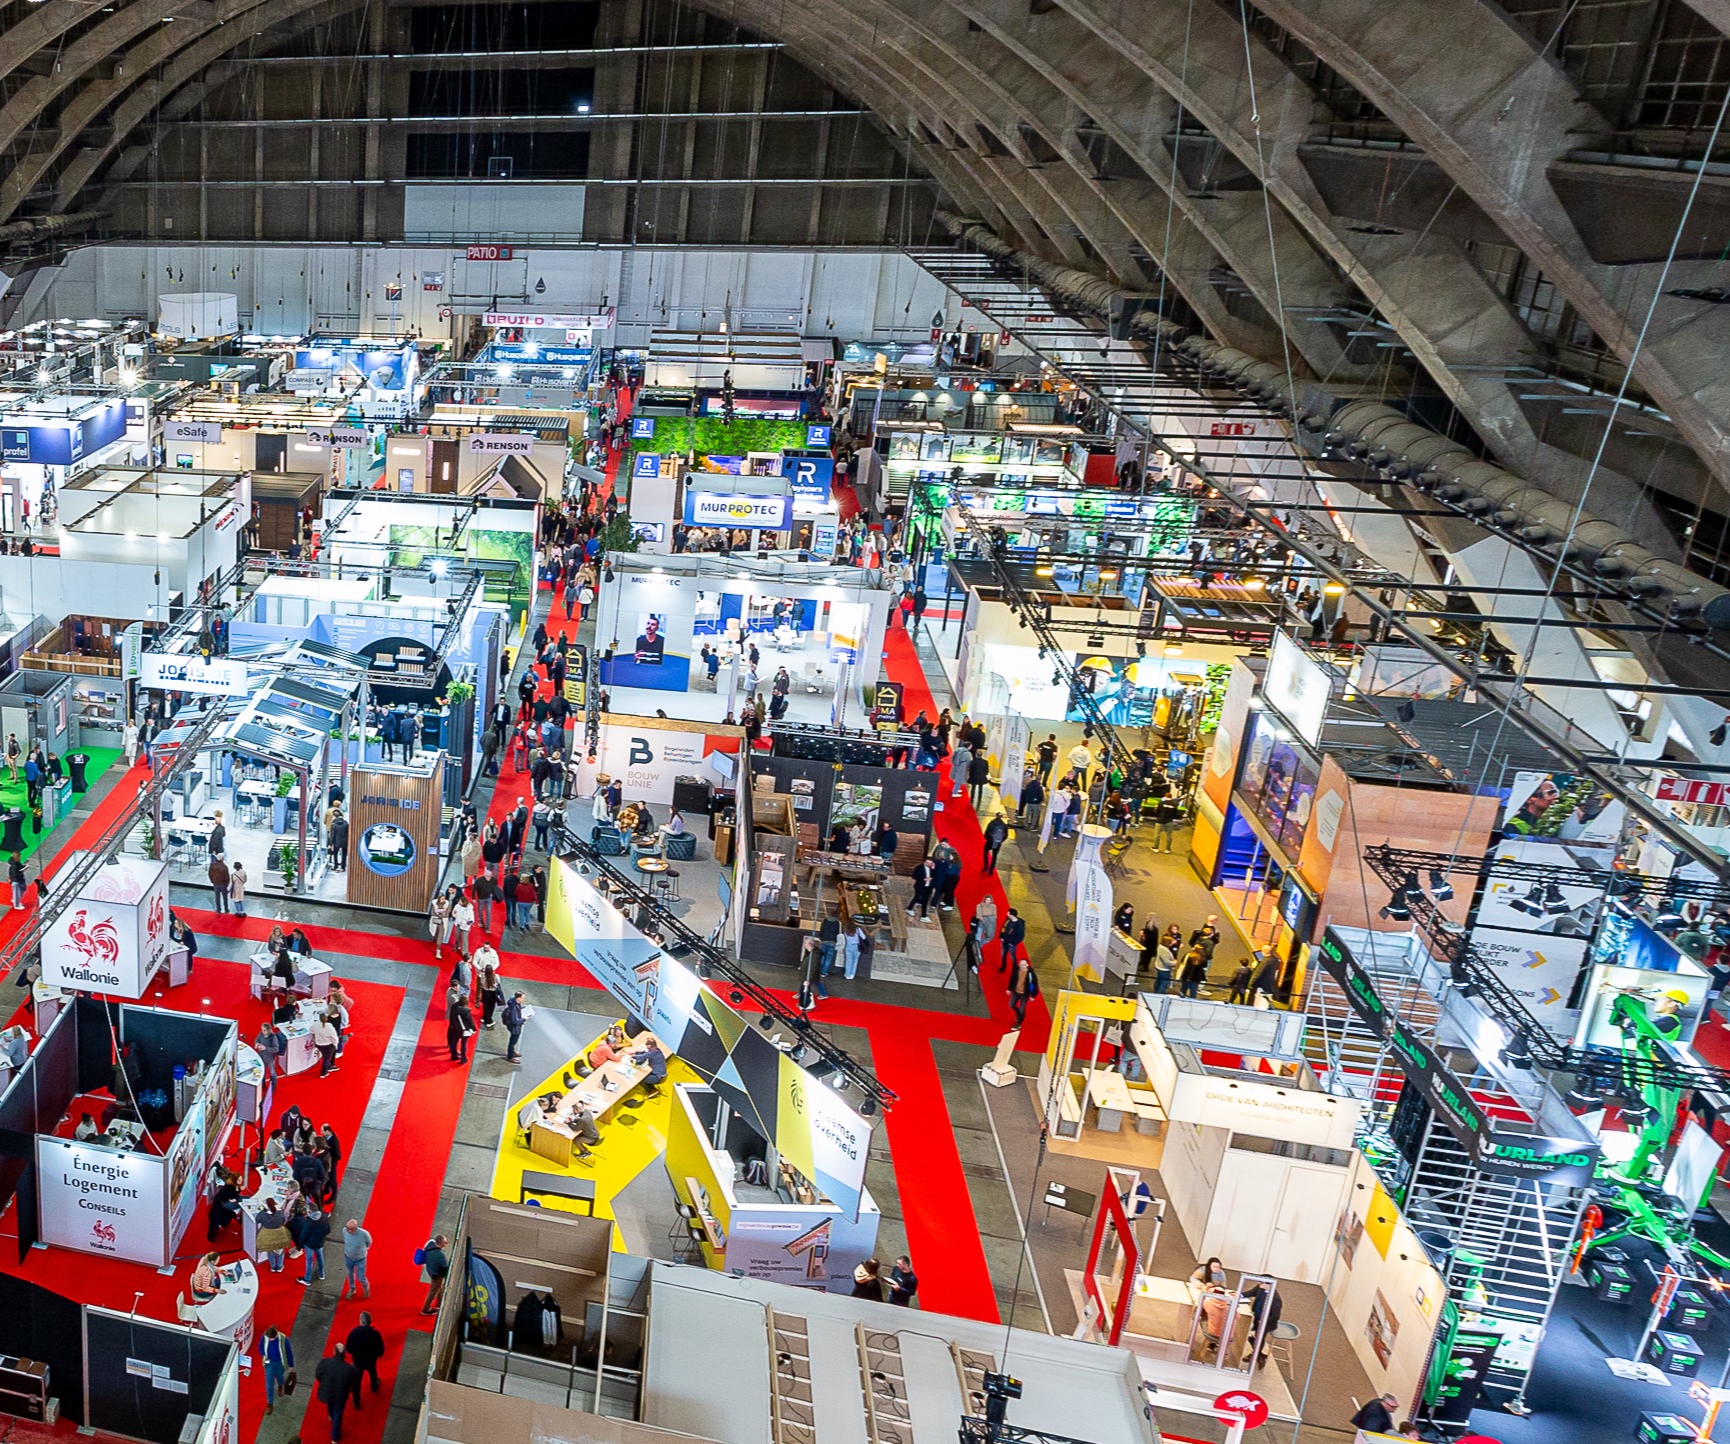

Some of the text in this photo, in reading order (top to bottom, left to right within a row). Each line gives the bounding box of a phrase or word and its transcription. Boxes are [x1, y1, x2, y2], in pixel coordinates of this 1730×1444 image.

[467, 247, 497, 259] PATIO
[176, 426, 208, 438] eSafe
[323, 435, 362, 444] RNSON
[486, 442, 528, 450] RENSON
[3, 447, 28, 458] profel
[701, 502, 778, 515] MURPROTEC
[627, 771, 661, 781] BOUW
[627, 779, 654, 789] UNIE
[1488, 942, 1521, 953] BOUW
[60, 965, 120, 986] Wallonie
[1206, 1092, 1334, 1118] ORDE VAN ARCHITECTEN
[814, 1118, 858, 1161] overheid
[73, 1154, 130, 1181] Énergie
[1488, 1156, 1520, 1169] HUREN
[63, 1173, 139, 1200] Logement
[89, 1241, 117, 1252] Wallonie
[748, 1265, 803, 1273] verbouwpremies
